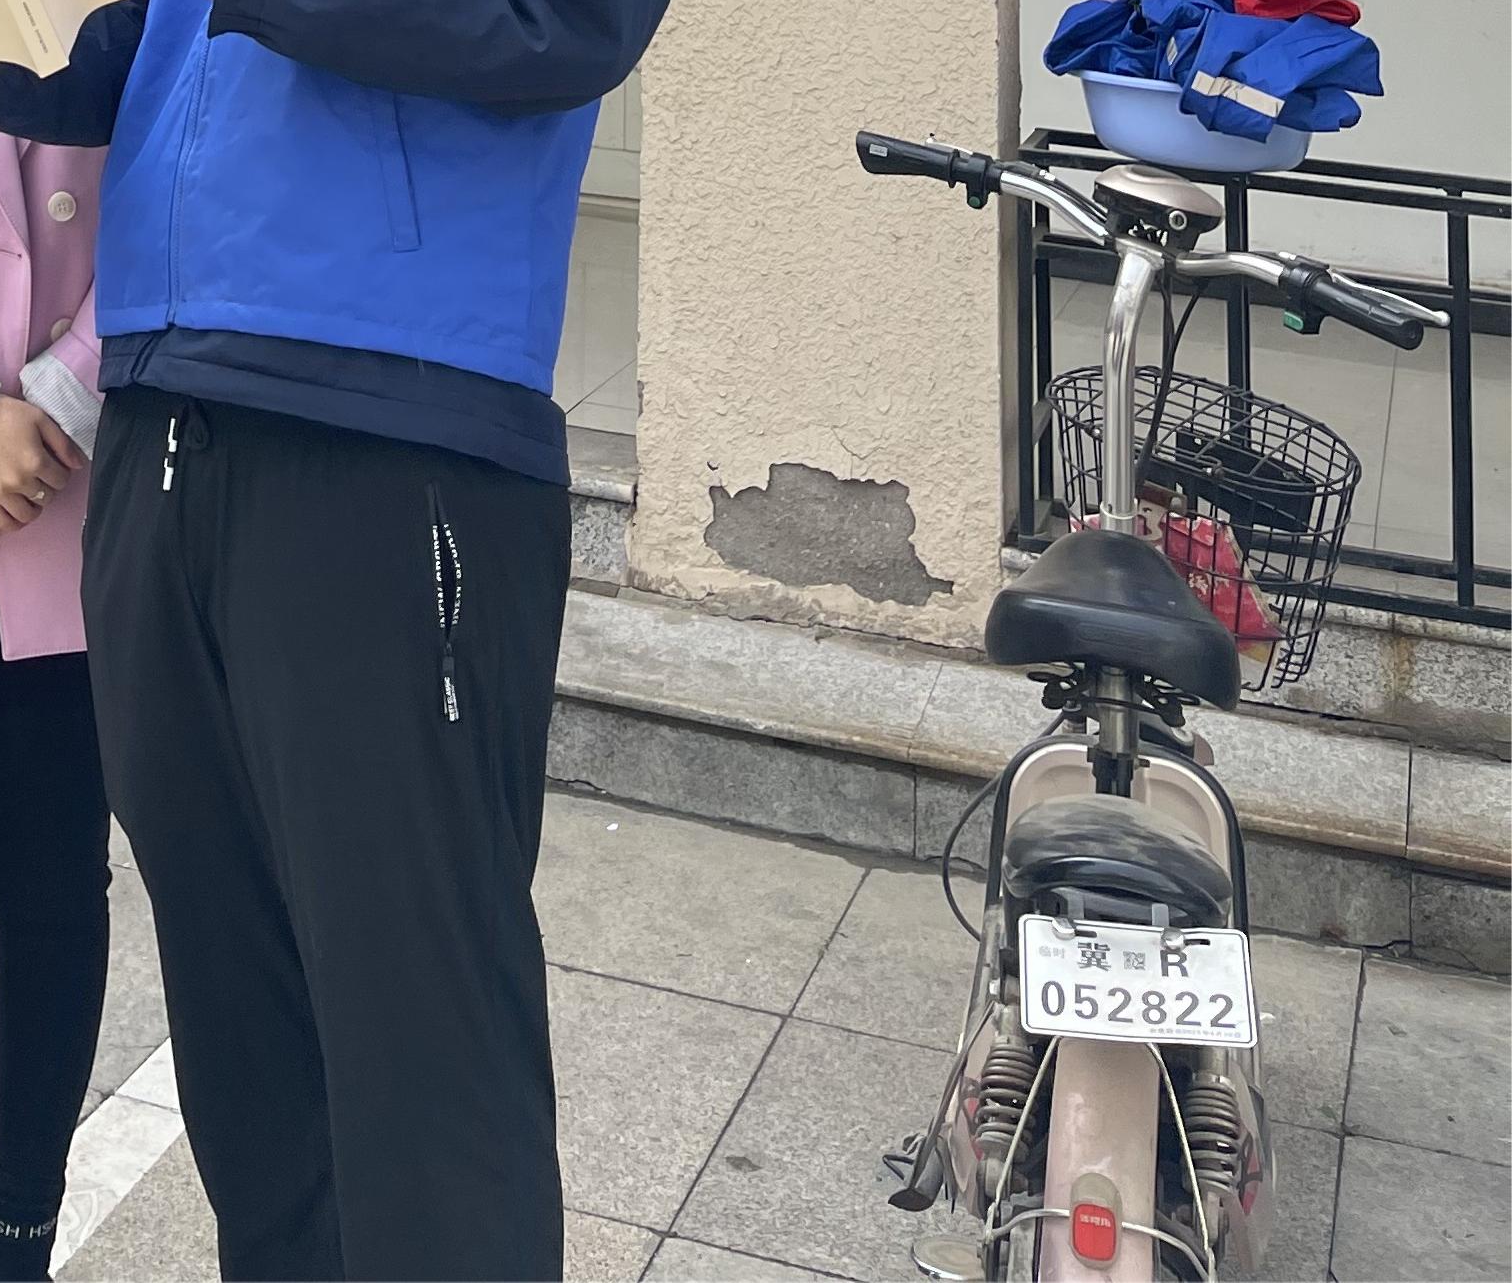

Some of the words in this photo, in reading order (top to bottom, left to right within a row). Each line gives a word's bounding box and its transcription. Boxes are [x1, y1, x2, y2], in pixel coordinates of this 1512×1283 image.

[1076, 941, 1113, 973] 冀
[1159, 948, 1190, 978] R
[1040, 979, 1238, 1030] 052822
